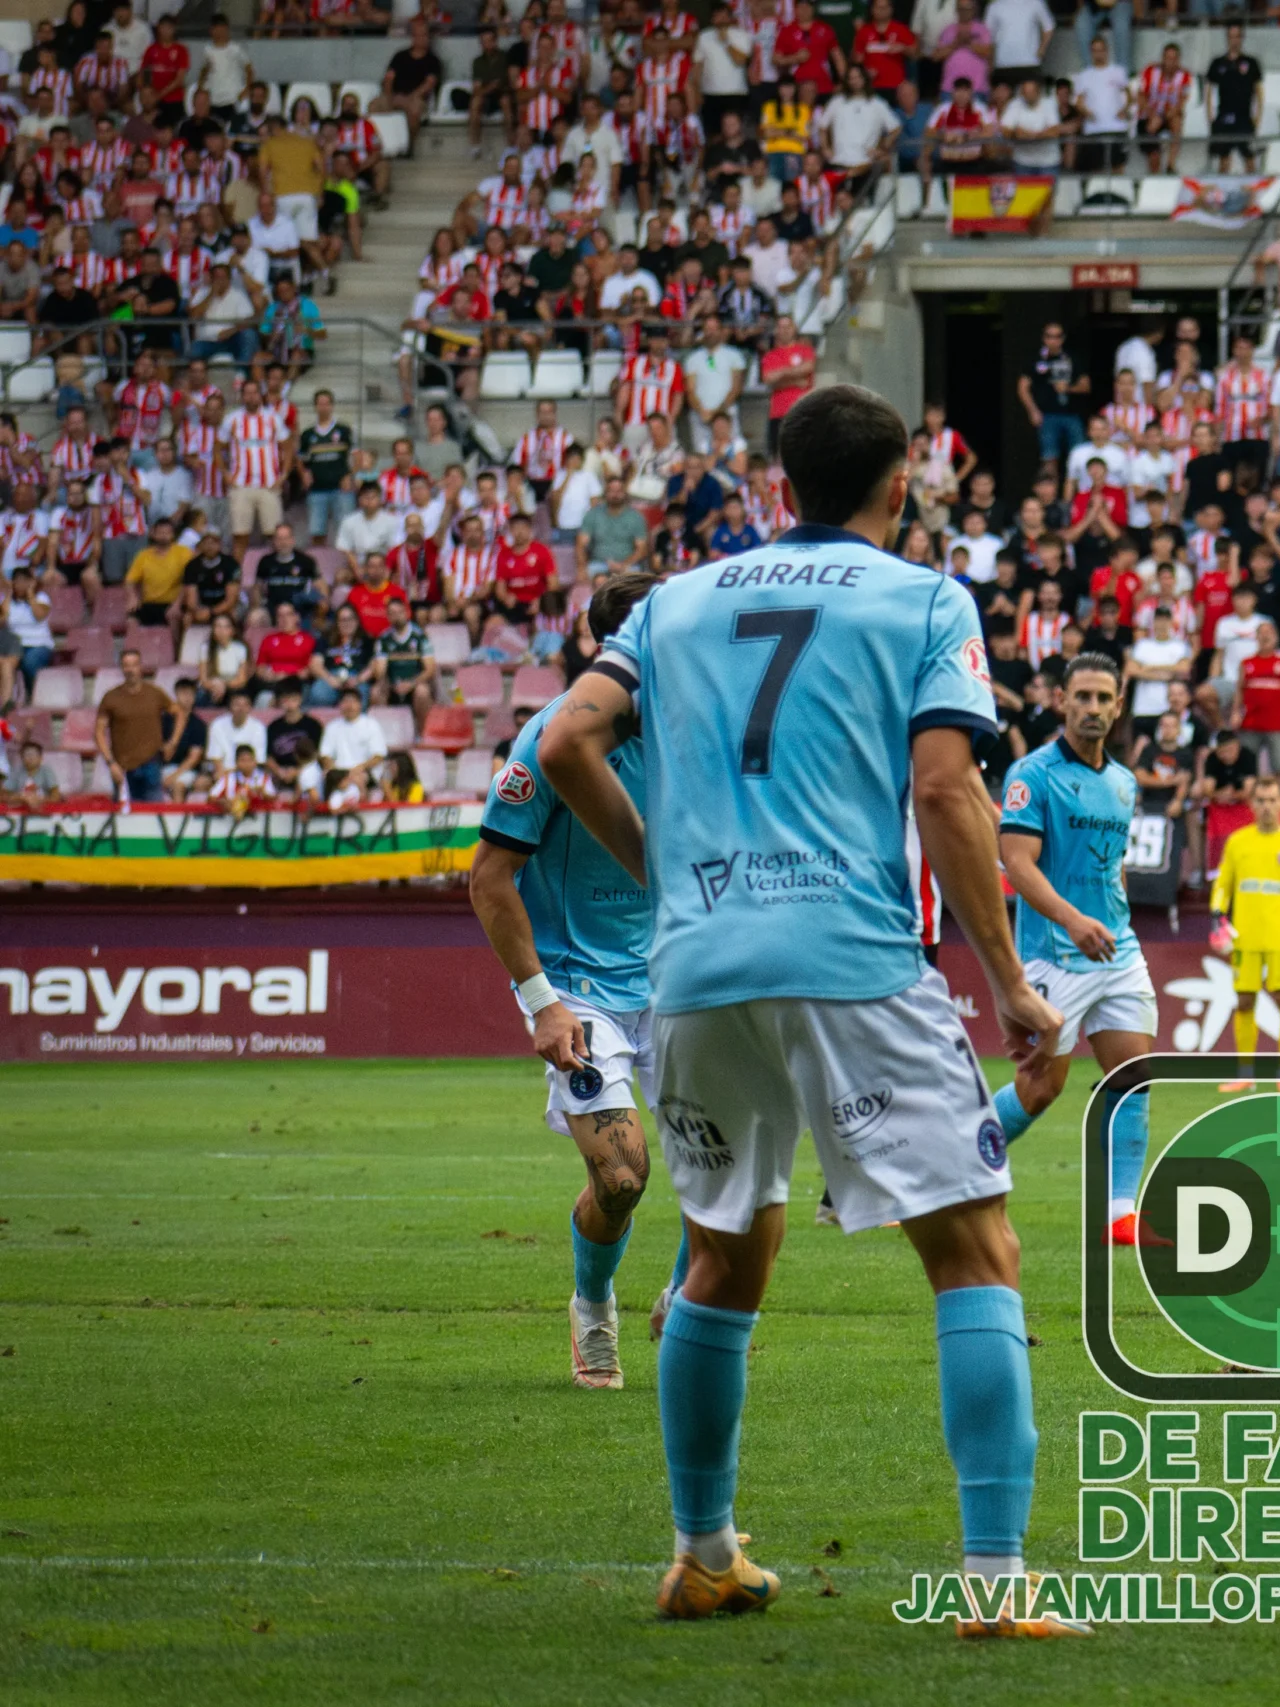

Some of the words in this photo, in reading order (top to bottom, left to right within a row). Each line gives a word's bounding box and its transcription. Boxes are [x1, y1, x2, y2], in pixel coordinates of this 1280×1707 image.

[715, 562, 867, 589] BARACE
[729, 604, 824, 780] 7
[158, 807, 399, 858] VIGUERA
[1069, 813, 1129, 838] telepizz
[747, 850, 849, 874] Reynolds
[745, 868, 850, 892] Verdasco
[40, 1032, 137, 1052] Suministros
[141, 1033, 234, 1052] Industriales
[235, 1036, 248, 1056] y
[251, 1032, 326, 1053] Servicios
[831, 1089, 886, 1126] ERØY
